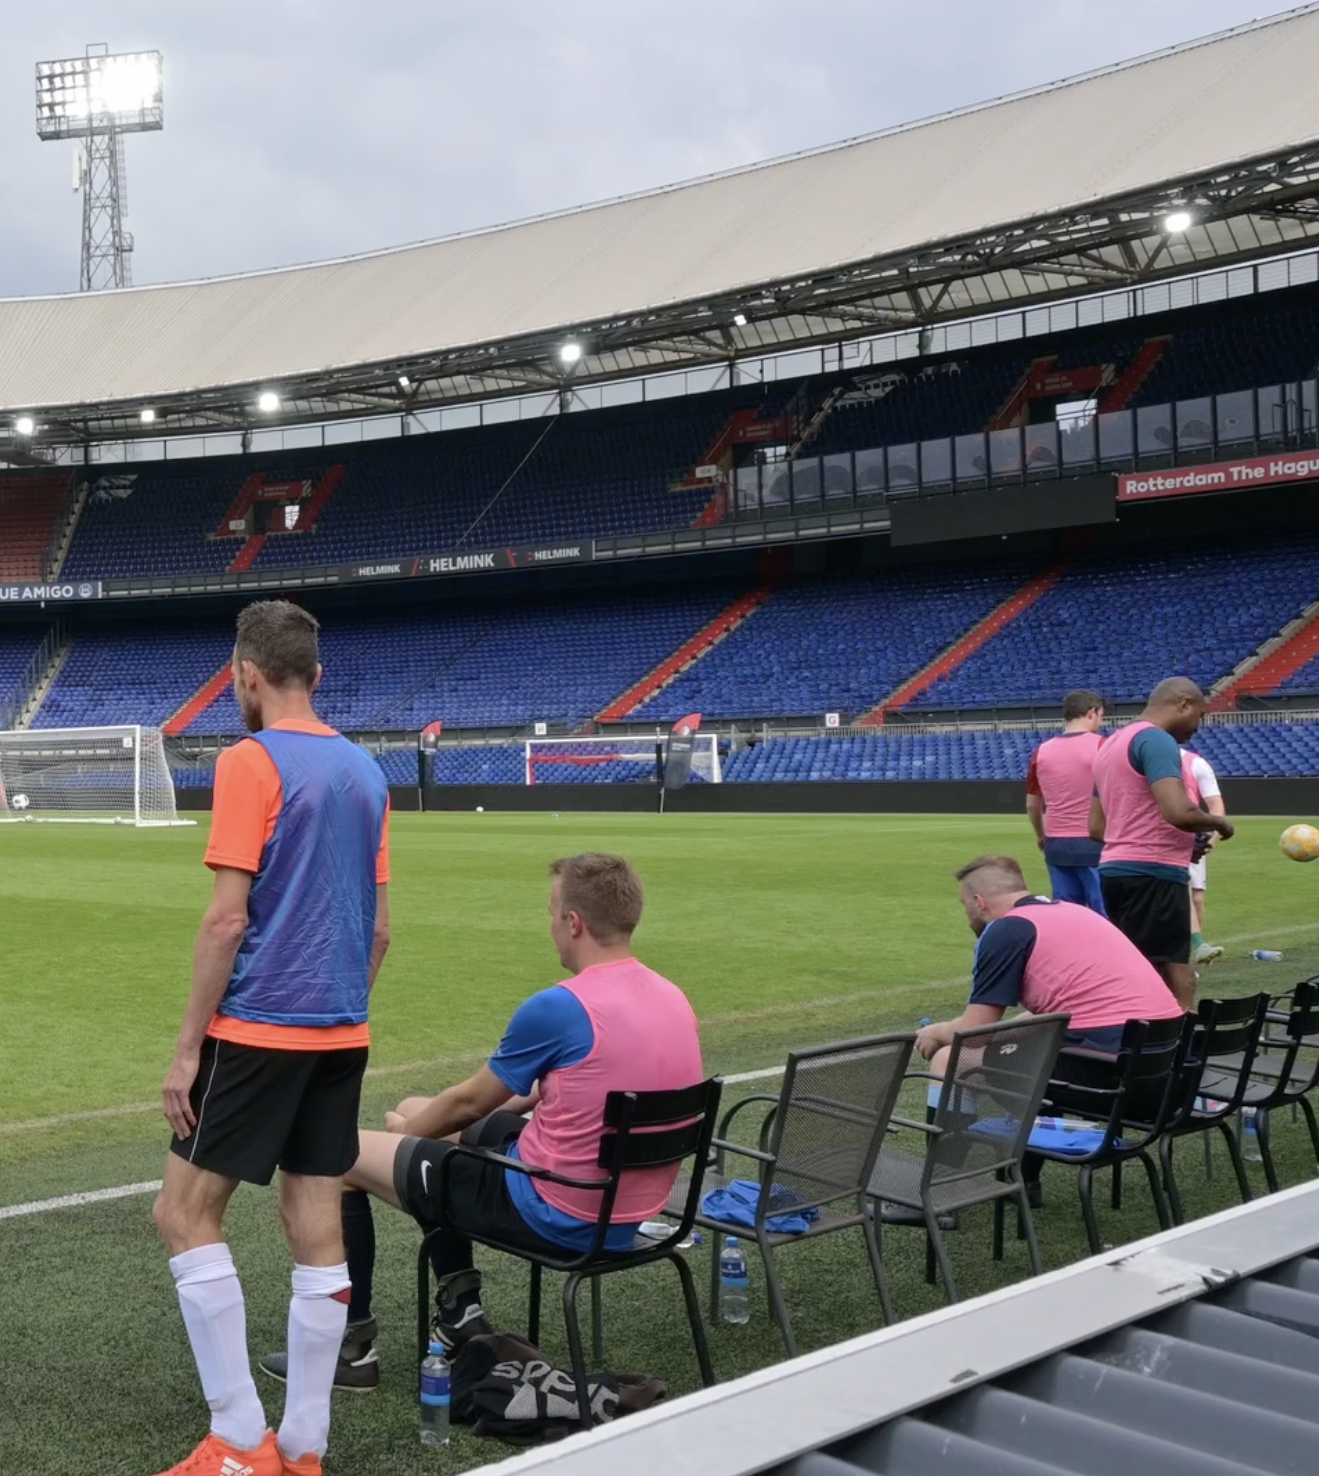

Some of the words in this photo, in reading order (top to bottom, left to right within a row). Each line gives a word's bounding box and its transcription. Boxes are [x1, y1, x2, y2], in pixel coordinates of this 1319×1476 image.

[1126, 471, 1226, 494] Rotterdam
[1230, 465, 1265, 481] The
[534, 547, 581, 560] HELMINK
[430, 553, 495, 572] HELMINK
[359, 564, 401, 576] HELMINK
[22, 585, 74, 599] AMIGO
[828, 715, 837, 725] G
